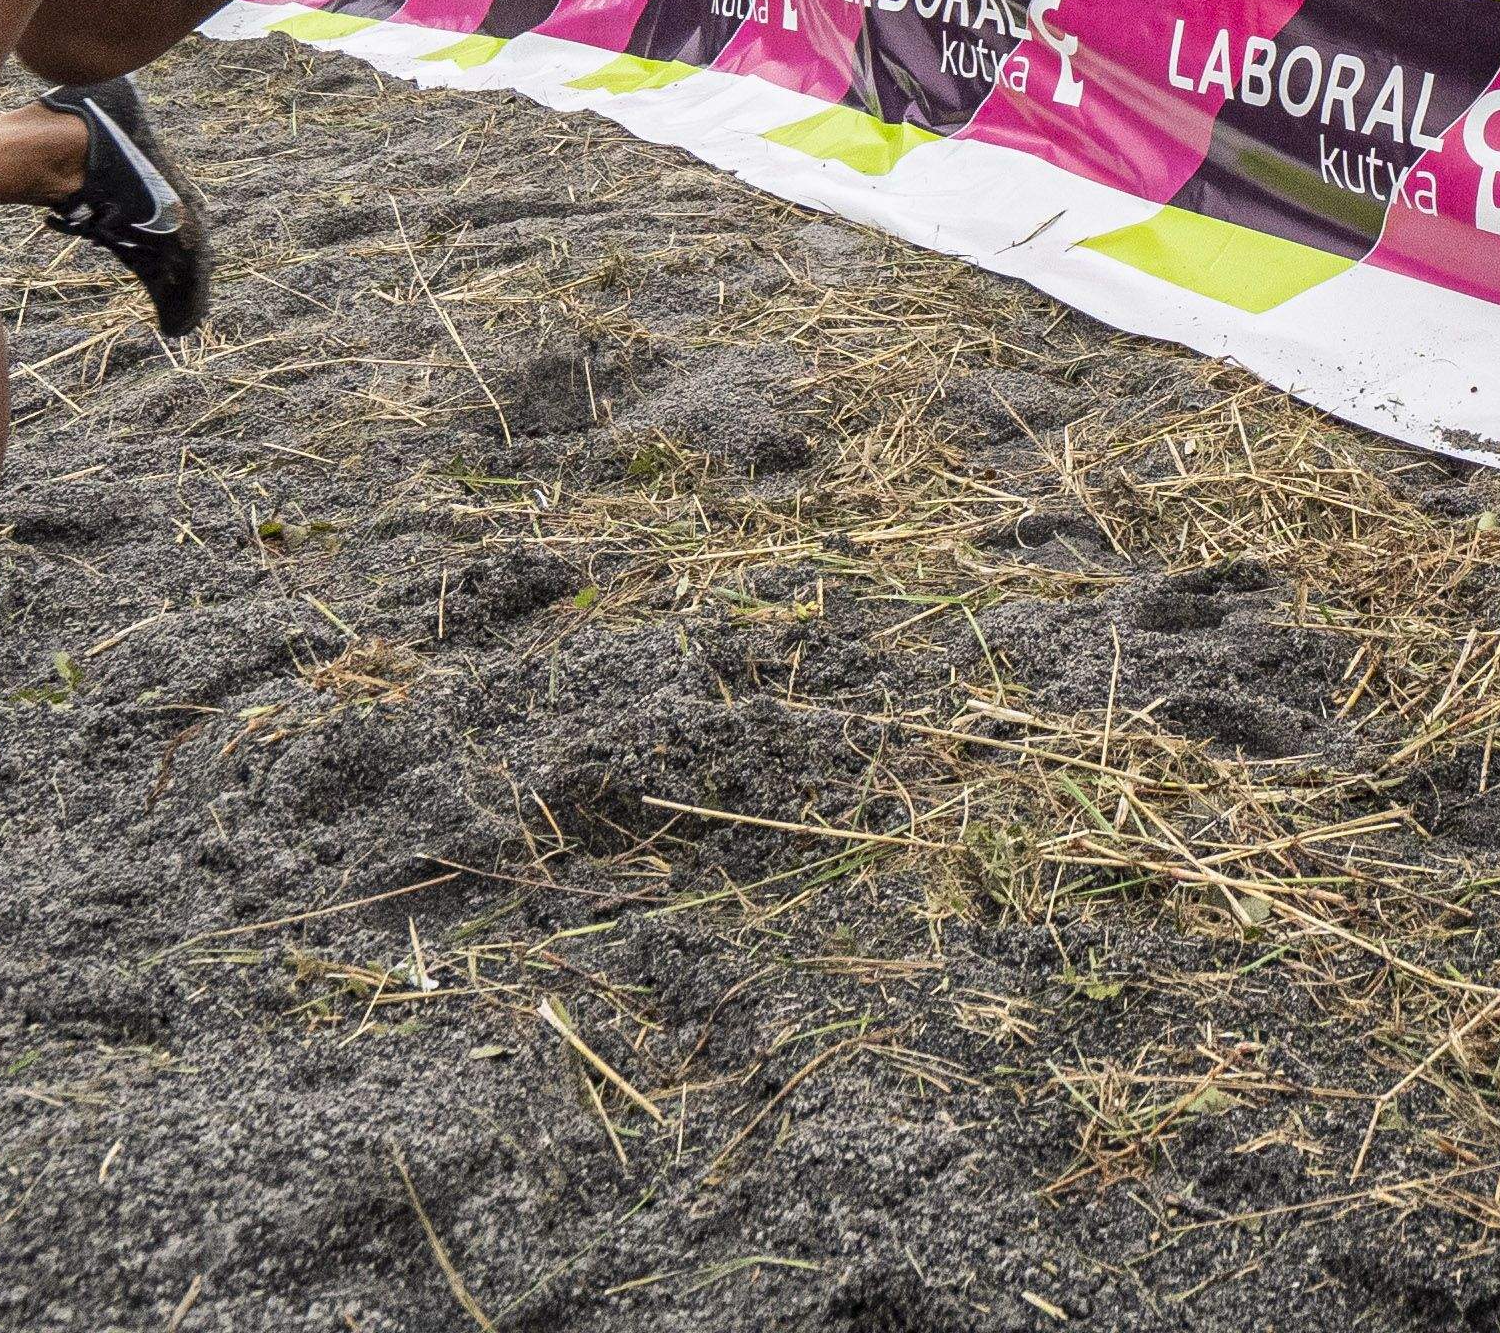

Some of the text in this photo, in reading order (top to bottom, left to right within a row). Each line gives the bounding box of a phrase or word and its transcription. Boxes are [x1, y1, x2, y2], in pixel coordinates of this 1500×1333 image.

[940, 29, 1031, 95] kutxa
[1167, 19, 1445, 154] LABORAL
[1317, 134, 1439, 217] kutxa
